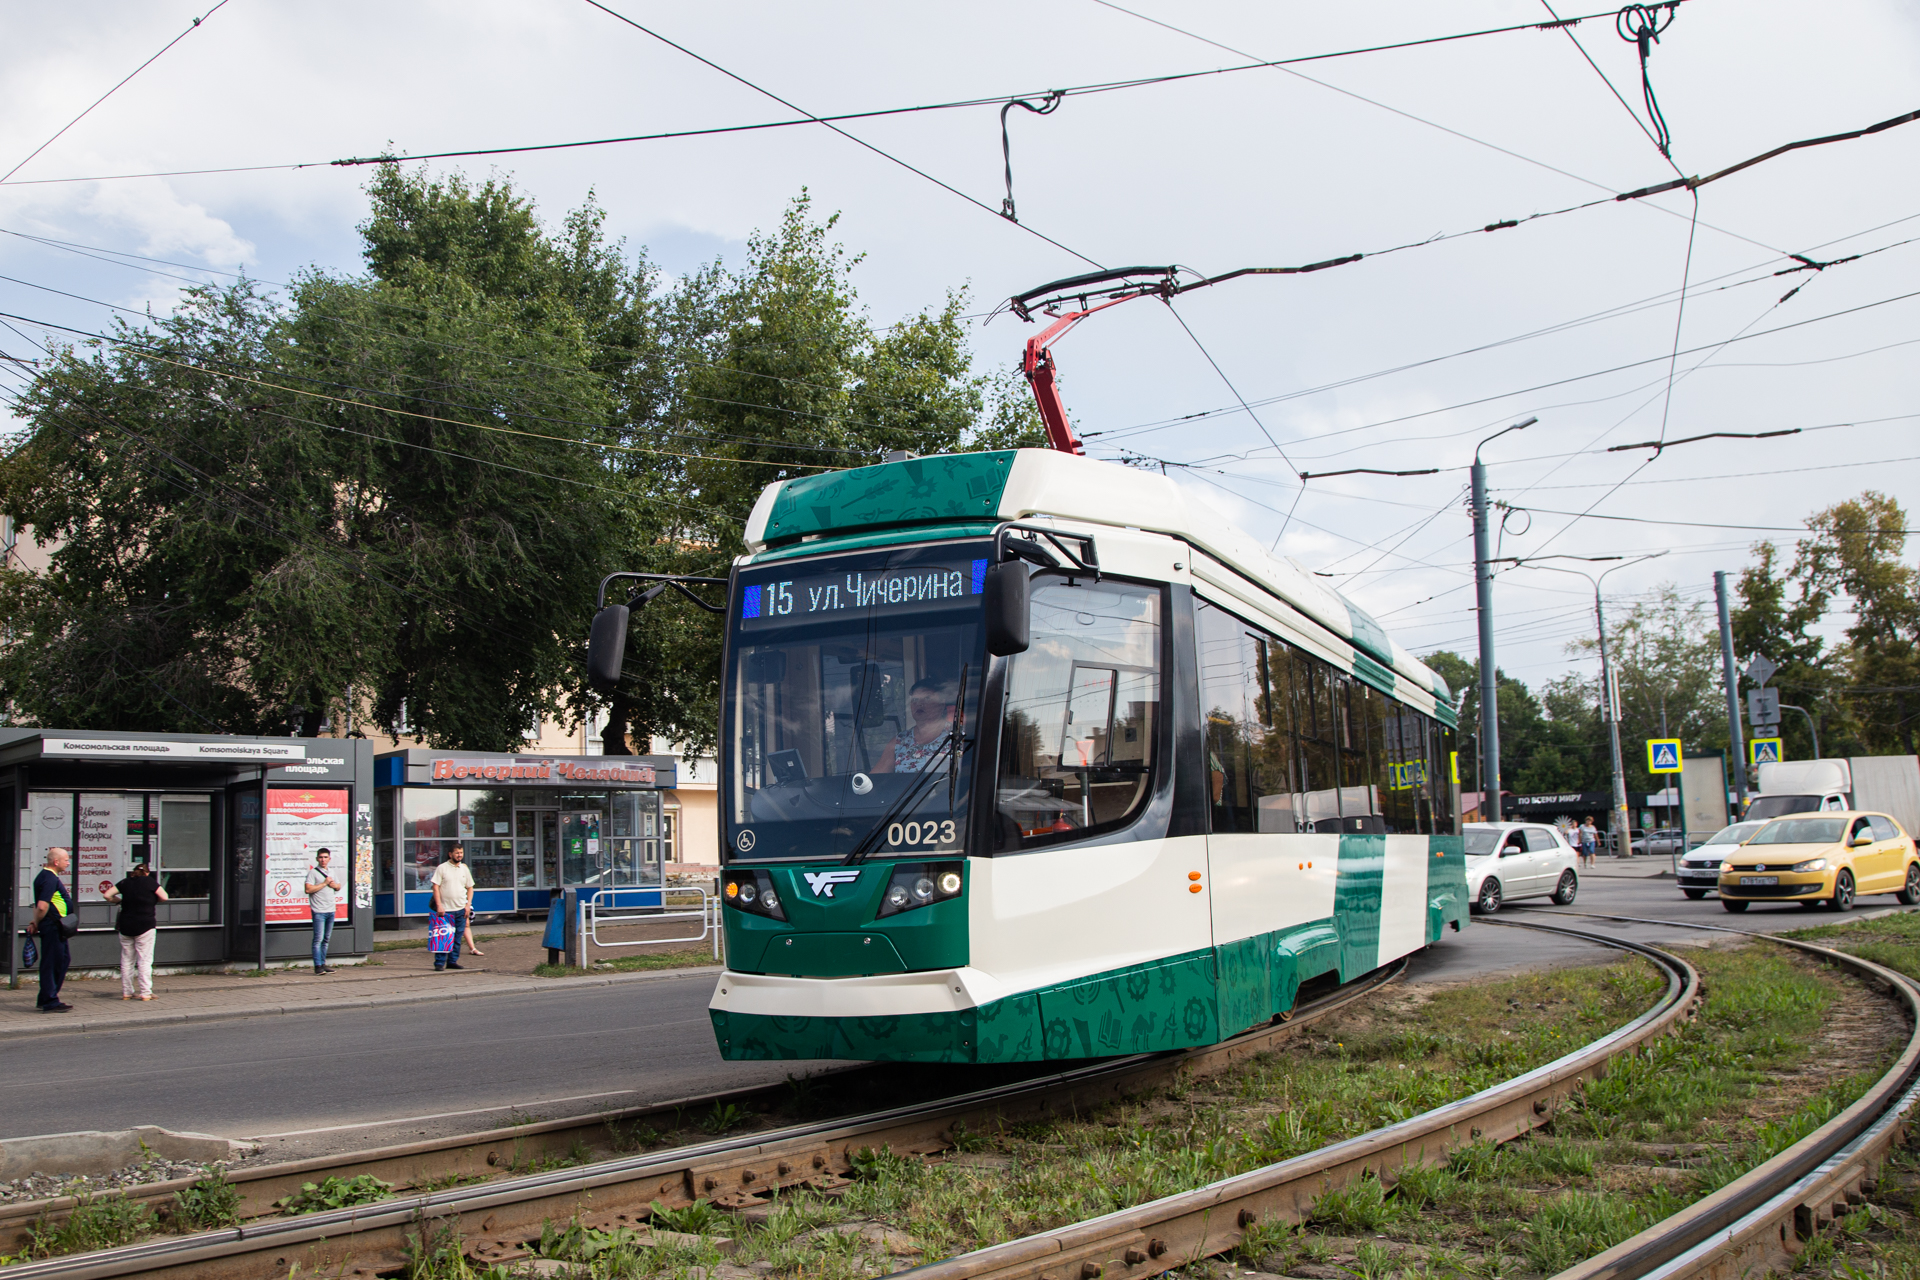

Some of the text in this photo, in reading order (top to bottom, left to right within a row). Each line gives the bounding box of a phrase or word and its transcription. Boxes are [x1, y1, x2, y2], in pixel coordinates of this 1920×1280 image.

[766, 581, 793, 616] 15
[64, 742, 170, 754] Комсомольская площадь
[199, 746, 288, 756] Komsomolskaya Square
[285, 766, 329, 774] площадь
[433, 760, 656, 783] Вечерний Челябинск
[1558, 794, 1582, 802] МИРУ
[888, 820, 956, 846] 0023
